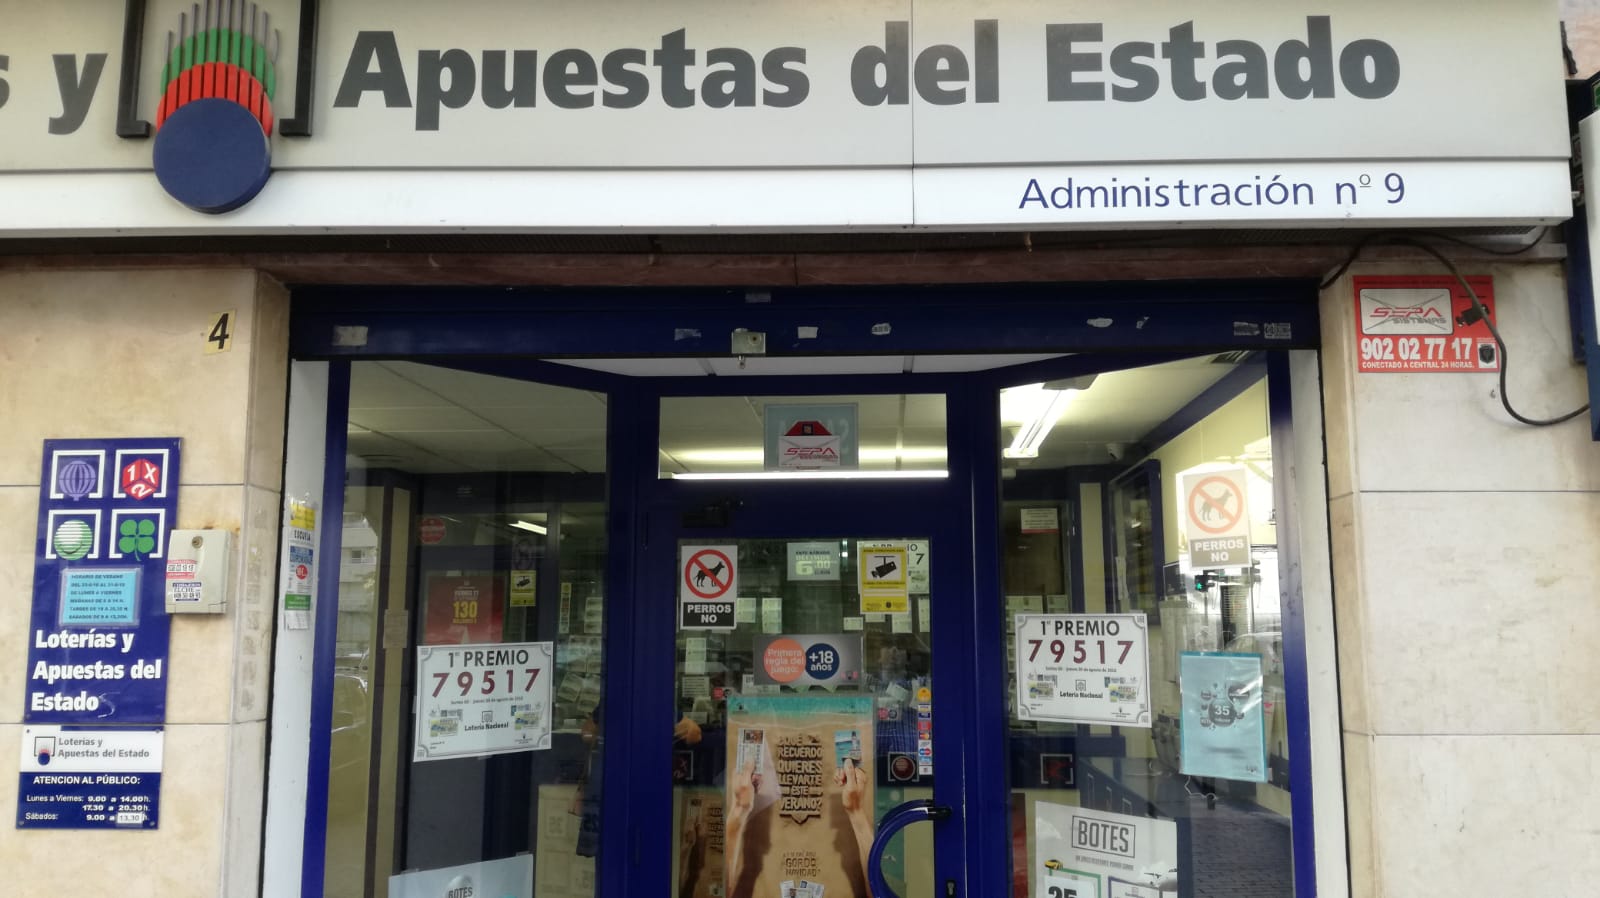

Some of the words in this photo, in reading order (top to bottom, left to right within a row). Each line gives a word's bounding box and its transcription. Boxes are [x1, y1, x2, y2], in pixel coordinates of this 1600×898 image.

[48, 53, 107, 135] y
[333, 27, 810, 131] Apuestas
[850, 19, 999, 106] del
[1045, 15, 1401, 102] Estado
[1018, 174, 1314, 209] Administración
[1336, 174, 1373, 204] nº
[1384, 172, 1406, 204] 9
[1370, 306, 1442, 318] SEPA
[208, 313, 229, 350] 4
[1361, 337, 1394, 360] 902
[1398, 337, 1421, 360] 02
[1424, 337, 1446, 360] 77
[1452, 337, 1473, 360] 17
[1362, 361, 1401, 369] CONECTADO
[1403, 361, 1408, 369] A
[1409, 361, 1439, 369] CENTRAL
[1441, 361, 1449, 369] 24
[784, 447, 836, 456] SEPA
[1194, 539, 1244, 551] PERROS
[1211, 552, 1229, 562] NO
[453, 601, 478, 618] 130
[687, 604, 732, 613] PERROS
[700, 614, 717, 623] NO
[1054, 620, 1120, 636] PREMIO
[35, 628, 116, 649] Loterías
[121, 632, 134, 653] y
[768, 648, 802, 657] Primera
[809, 650, 834, 664] +18
[1028, 639, 1134, 665] 79517
[464, 649, 529, 668] PREMIO
[765, 656, 788, 666] regla
[790, 656, 804, 665] del
[32, 659, 124, 685] Apuestas
[130, 659, 162, 679] del
[811, 663, 832, 671] años
[432, 668, 541, 698] 79517
[31, 690, 99, 712] Estado
[1215, 705, 1230, 716] 35
[97, 739, 103, 748] y
[57, 748, 99, 759] Apuestas
[102, 748, 116, 758] del
[118, 748, 150, 758] Estado
[778, 747, 823, 759] RECUERDO
[778, 760, 823, 773] QUIERES
[33, 775, 80, 785] ATENCION
[81, 776, 95, 785] AL
[96, 774, 141, 785] PÚBLICO:
[778, 774, 823, 786] LLEVARTE
[791, 786, 809, 796] ESTE
[26, 794, 49, 802] Lunes
[55, 794, 84, 802] Viernes:
[780, 798, 823, 811] VERANO?
[25, 812, 58, 820] Sábados:
[1078, 820, 1129, 853] BOTES
[785, 858, 816, 868] GORDO
